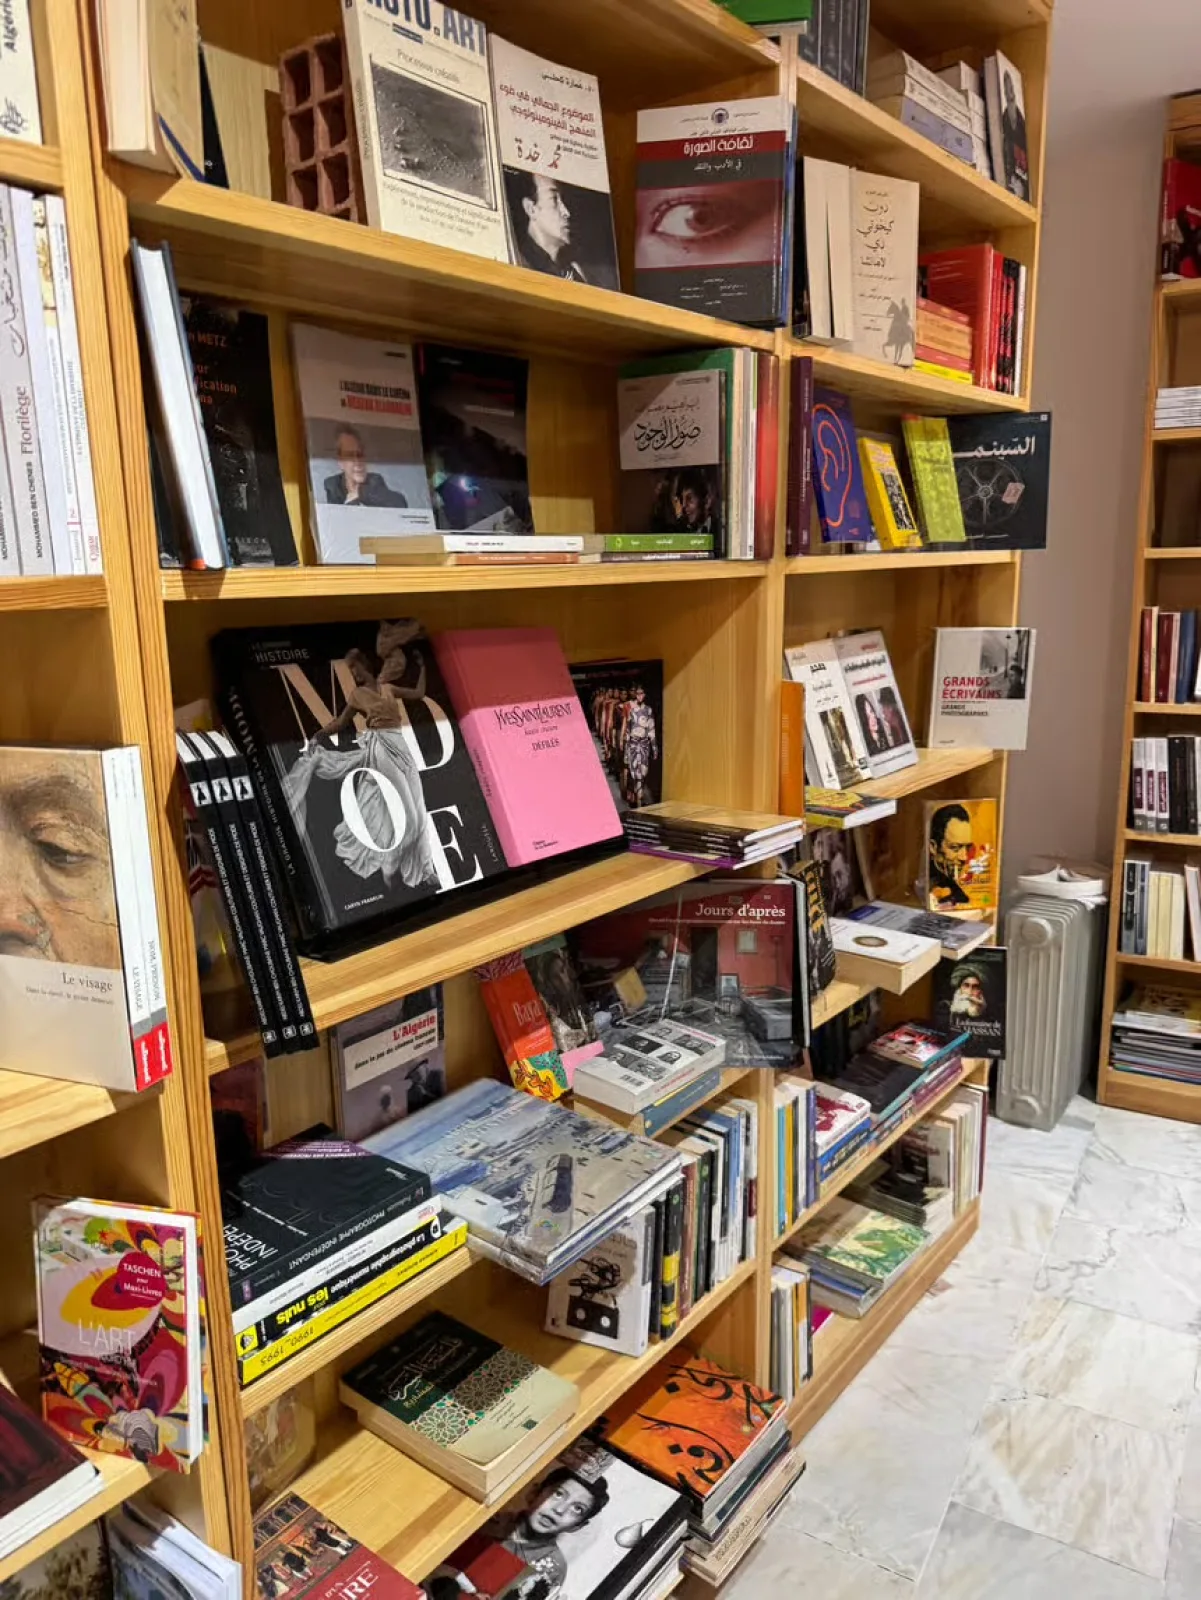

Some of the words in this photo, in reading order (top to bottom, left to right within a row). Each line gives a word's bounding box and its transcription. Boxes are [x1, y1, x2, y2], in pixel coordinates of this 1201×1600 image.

[562, 106, 595, 122] الموضوع
[684, 139, 716, 157] الصورة
[717, 135, 753, 152] ثقافة
[198, 334, 227, 348] METZ
[16, 385, 33, 455] Florilège
[255, 648, 310, 662] HISTOIRE
[943, 676, 991, 687] GRANDS
[695, 903, 734, 916] Jours
[737, 904, 786, 920] d'après
[62, 972, 74, 985] Le
[79, 976, 113, 993] visage
[512, 1000, 542, 1026] Baya
[393, 1014, 436, 1041] L'Algérie
[336, 1209, 387, 1242] PHOTOGRAPHE
[414, 1233, 425, 1243] La
[224, 1246, 257, 1270] PHO
[286, 1236, 339, 1270] INDÉPENDANT
[367, 1237, 418, 1271] photographie
[123, 1263, 161, 1277] TASCHEN
[327, 1264, 372, 1294] numérique
[124, 1283, 162, 1297] Maxi-Livres
[304, 1285, 331, 1308] les
[273, 1299, 308, 1327] nuls
[79, 1318, 136, 1355] L'ART
